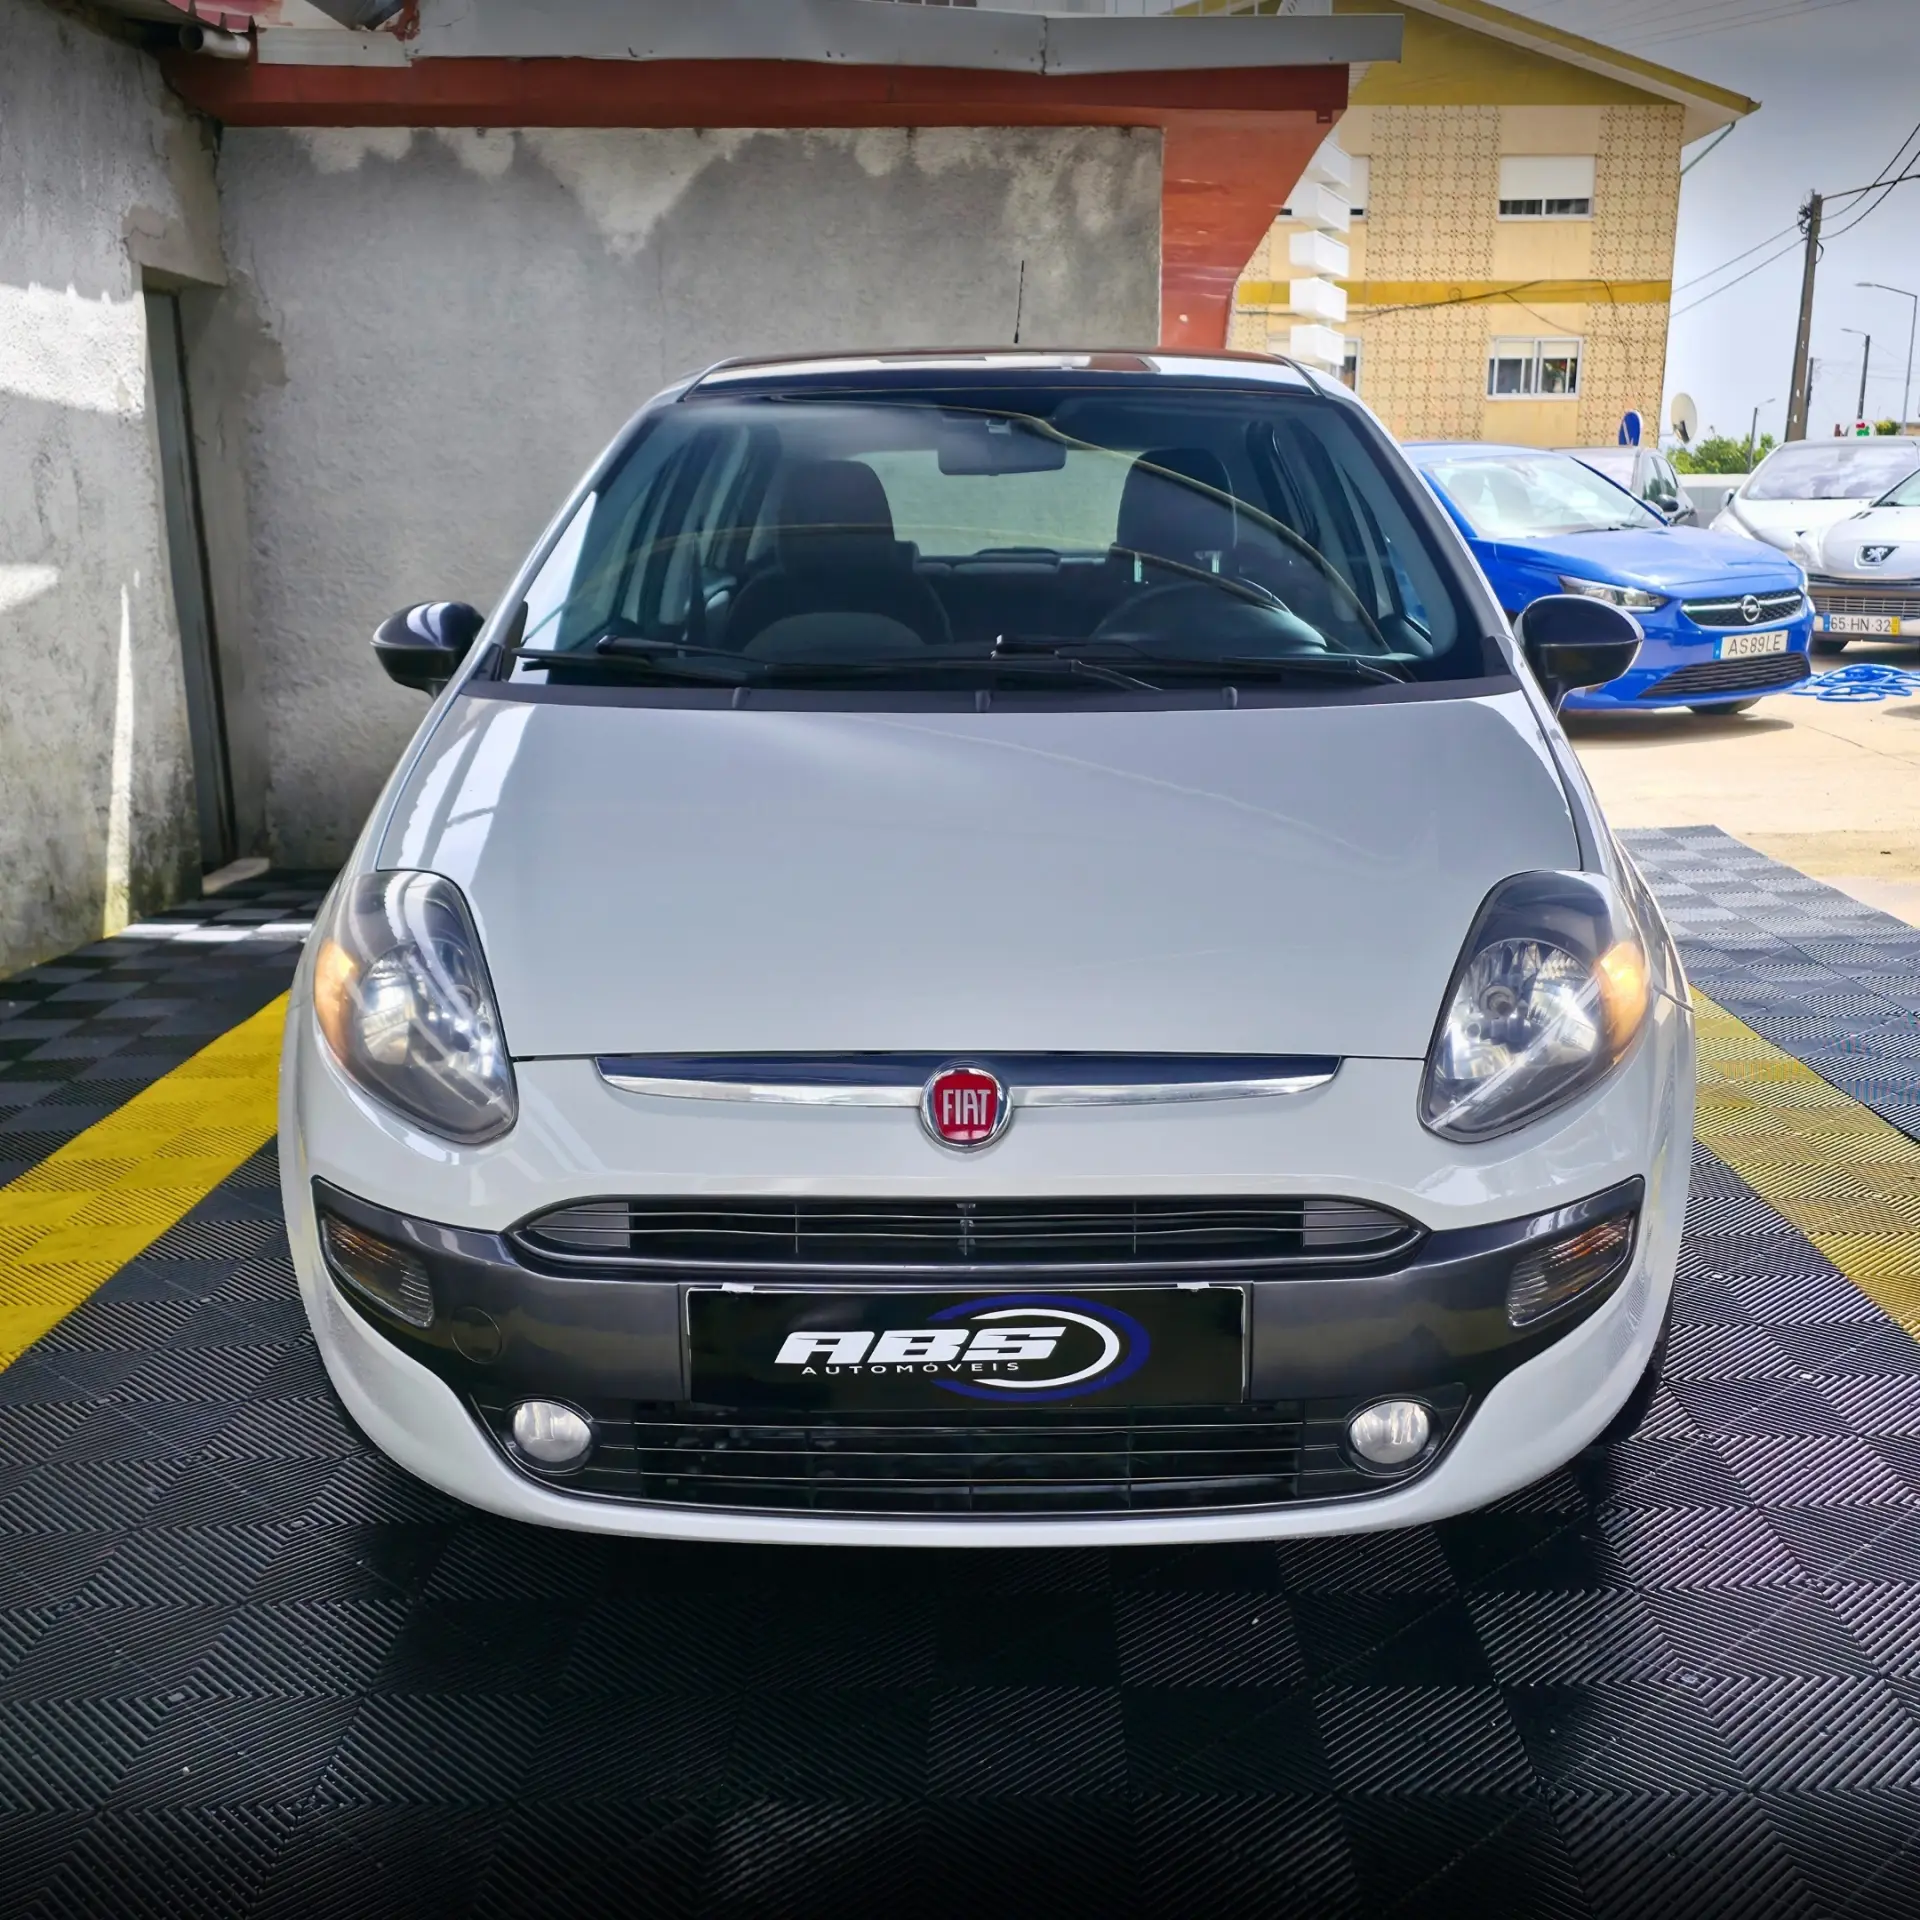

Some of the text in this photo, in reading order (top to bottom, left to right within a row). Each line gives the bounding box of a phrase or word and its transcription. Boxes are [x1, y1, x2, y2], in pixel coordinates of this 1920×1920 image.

[943, 1089, 991, 1125] FIAT
[774, 1326, 1067, 1364] ABS
[801, 1361, 1019, 1375] AUTOMÓVEIS
